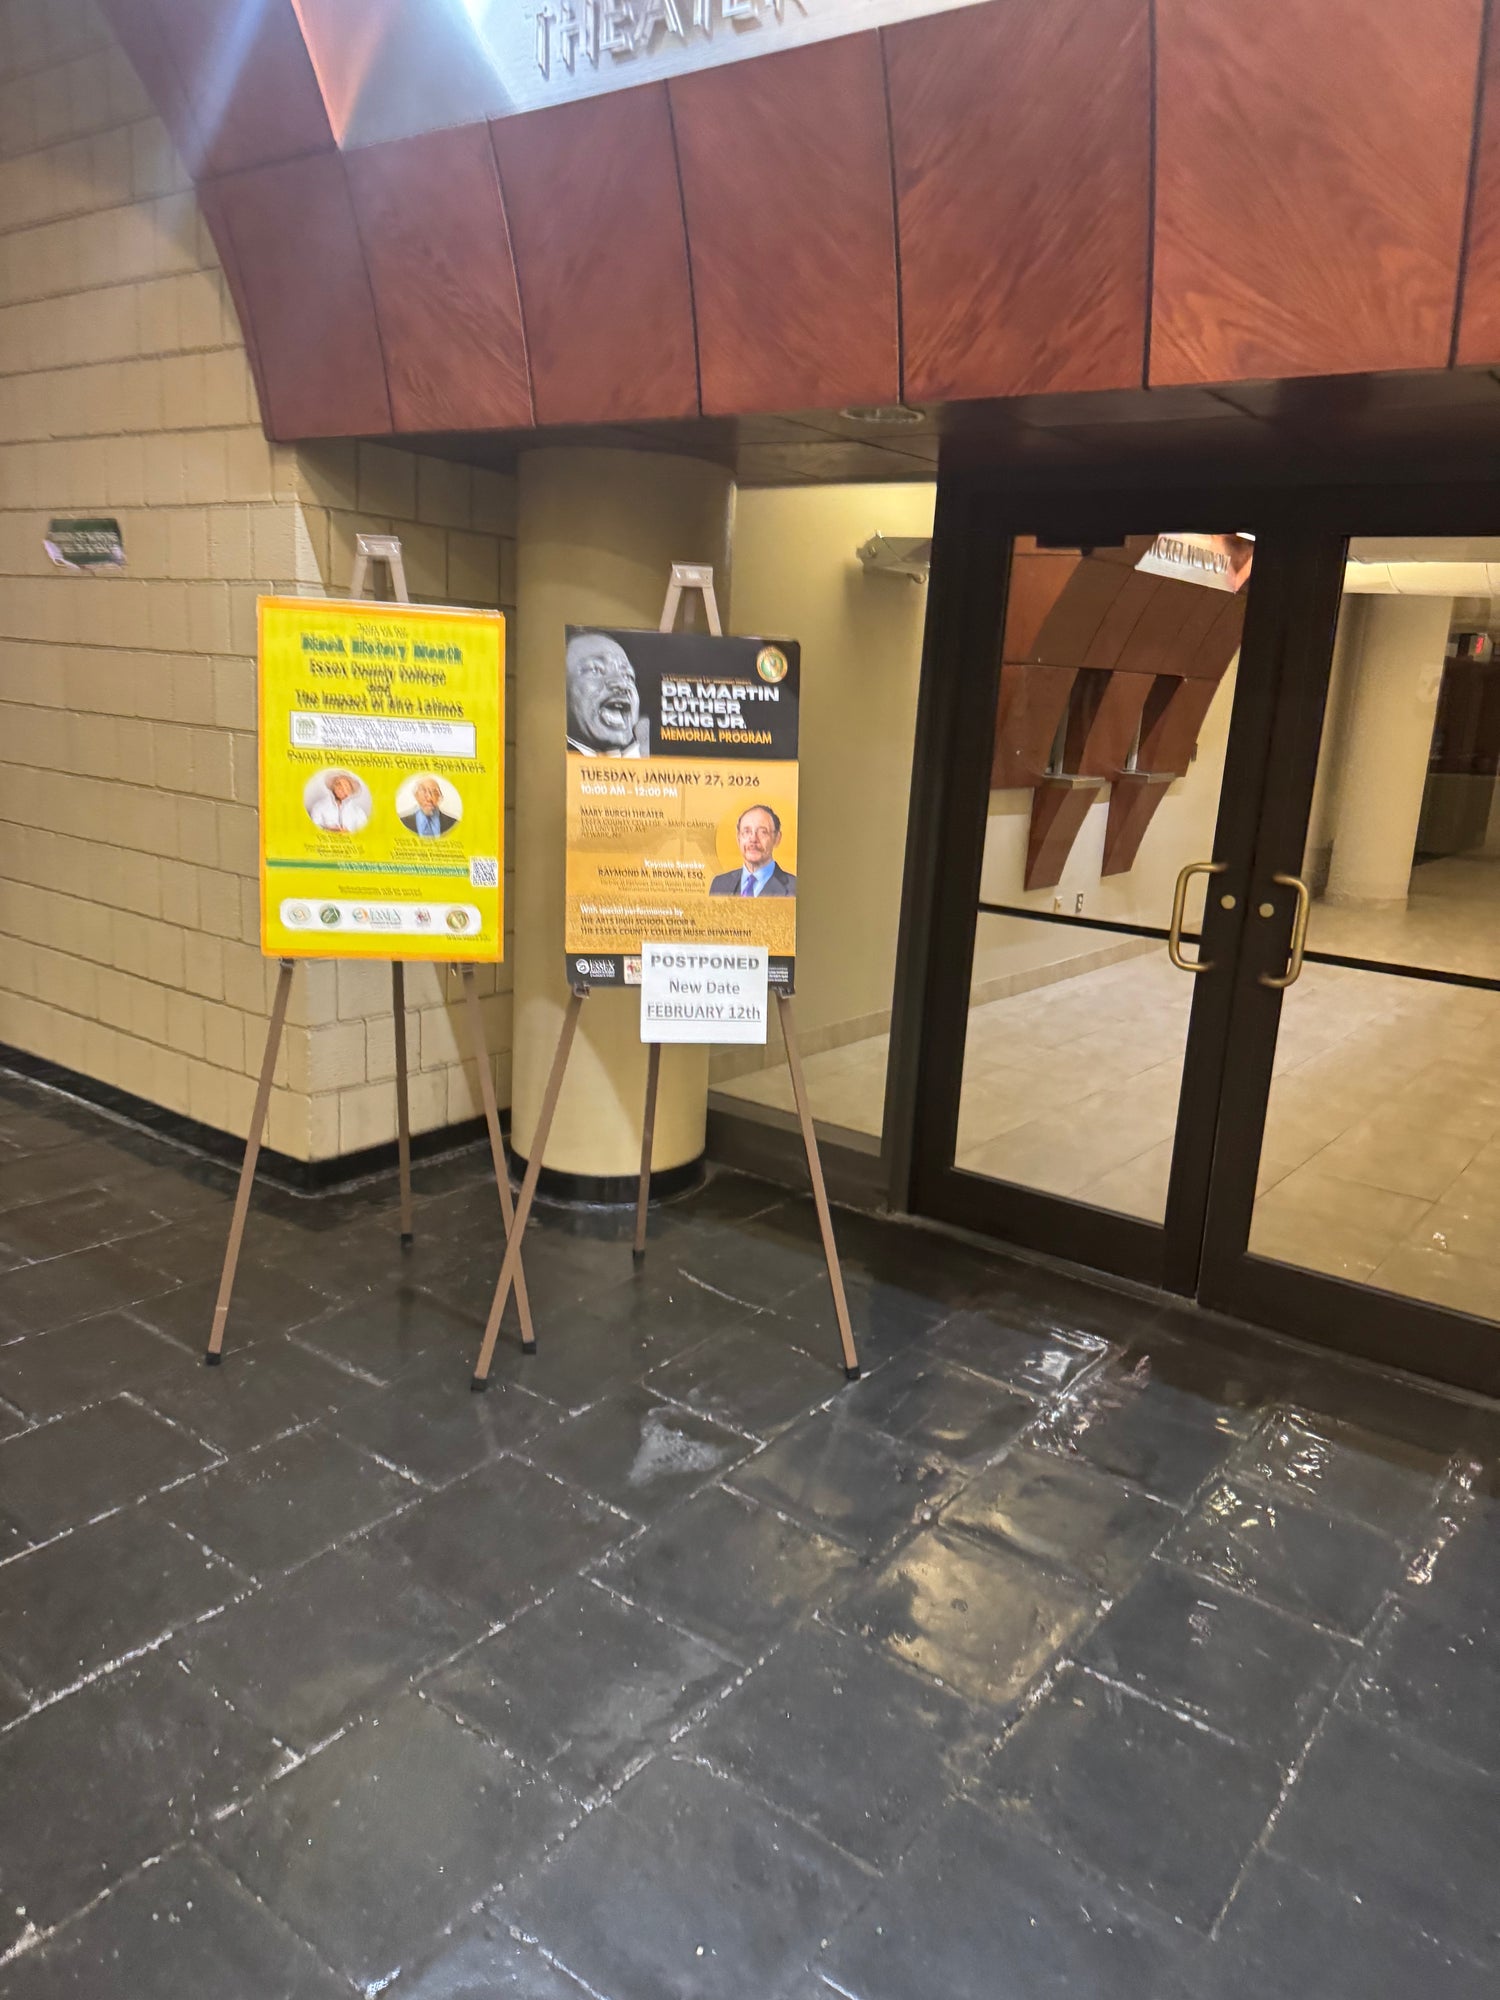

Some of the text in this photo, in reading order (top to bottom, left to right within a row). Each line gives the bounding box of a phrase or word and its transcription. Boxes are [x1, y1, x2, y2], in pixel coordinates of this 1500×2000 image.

[536, 0, 806, 74] THEA
[697, 681, 780, 702] MARTIN
[662, 696, 741, 714] LUTHER
[661, 711, 714, 728] KING
[661, 727, 773, 745] MEMORIAL PROGRAM
[581, 768, 760, 788] TUESDAY, JANUARY 27, 2026
[581, 784, 608, 796] 10:00
[610, 786, 626, 797] AM
[634, 786, 661, 798] 12:00
[663, 787, 678, 798] PM
[580, 807, 664, 820] MARY BURCH THEATER
[598, 868, 639, 879] RAYMOND
[580, 904, 683, 918] With special performances by
[596, 917, 614, 925] ARTS
[636, 918, 666, 926] SCHOOL
[596, 928, 618, 936] ESSEX
[620, 928, 648, 936] COUNTY
[651, 929, 681, 937] COLLEGE
[683, 929, 707, 937] MUSIC
[708, 929, 752, 938] DEPARTMENT
[651, 954, 760, 970] POSTPONED
[669, 979, 740, 995] New Date
[647, 1004, 760, 1020] FEBRUARY 12th
